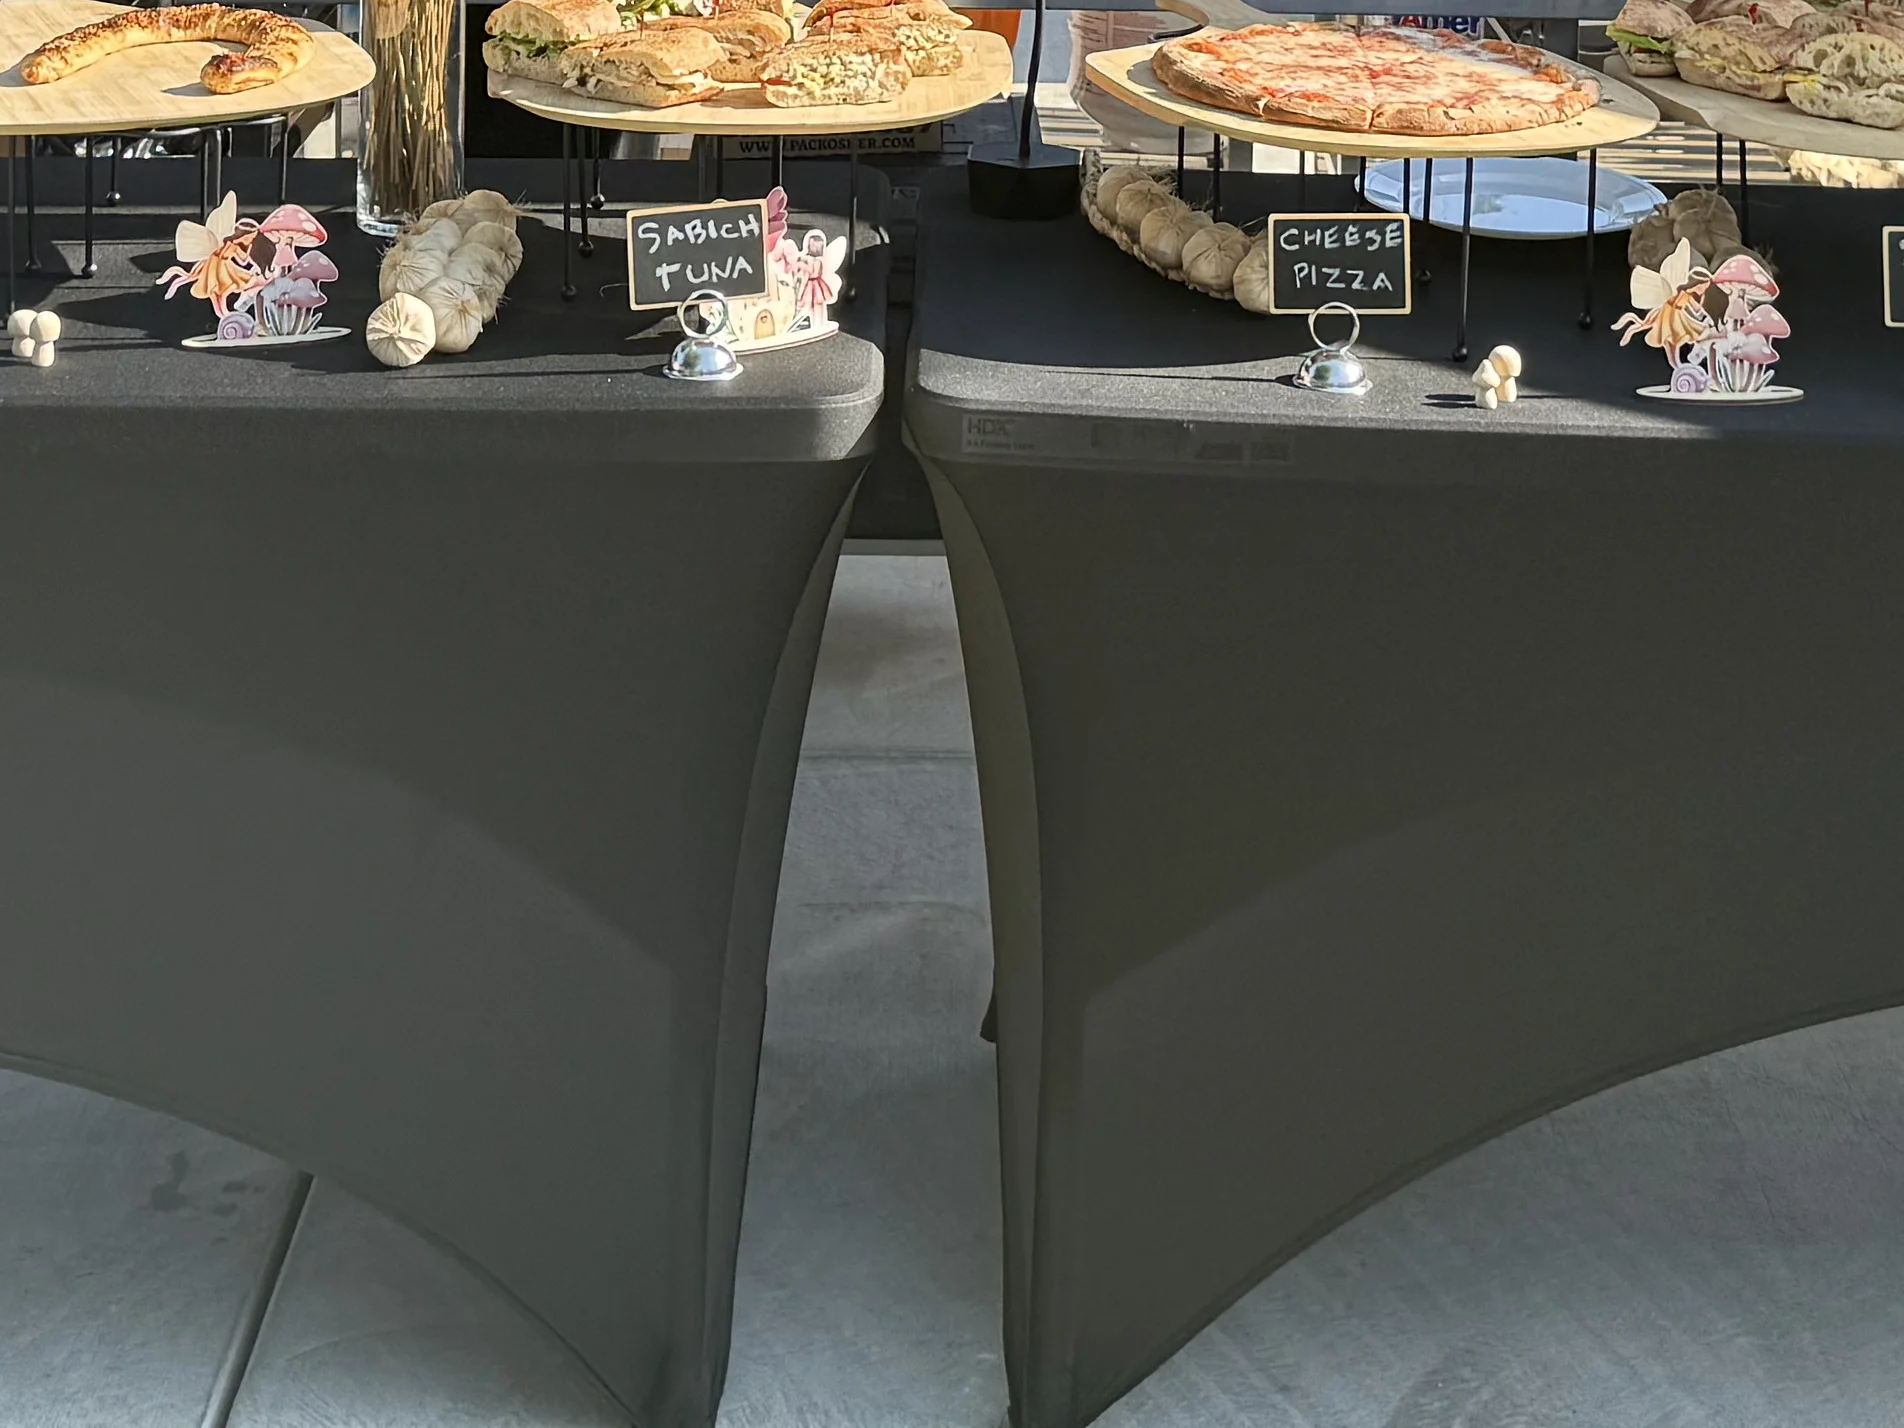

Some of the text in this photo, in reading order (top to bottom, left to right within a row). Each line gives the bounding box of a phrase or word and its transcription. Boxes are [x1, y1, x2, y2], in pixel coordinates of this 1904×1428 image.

[637, 213, 760, 254] SABICH
[1279, 222, 1403, 251] CHEESE
[655, 256, 753, 292] TUNA
[1293, 262, 1394, 292] PIZZA
